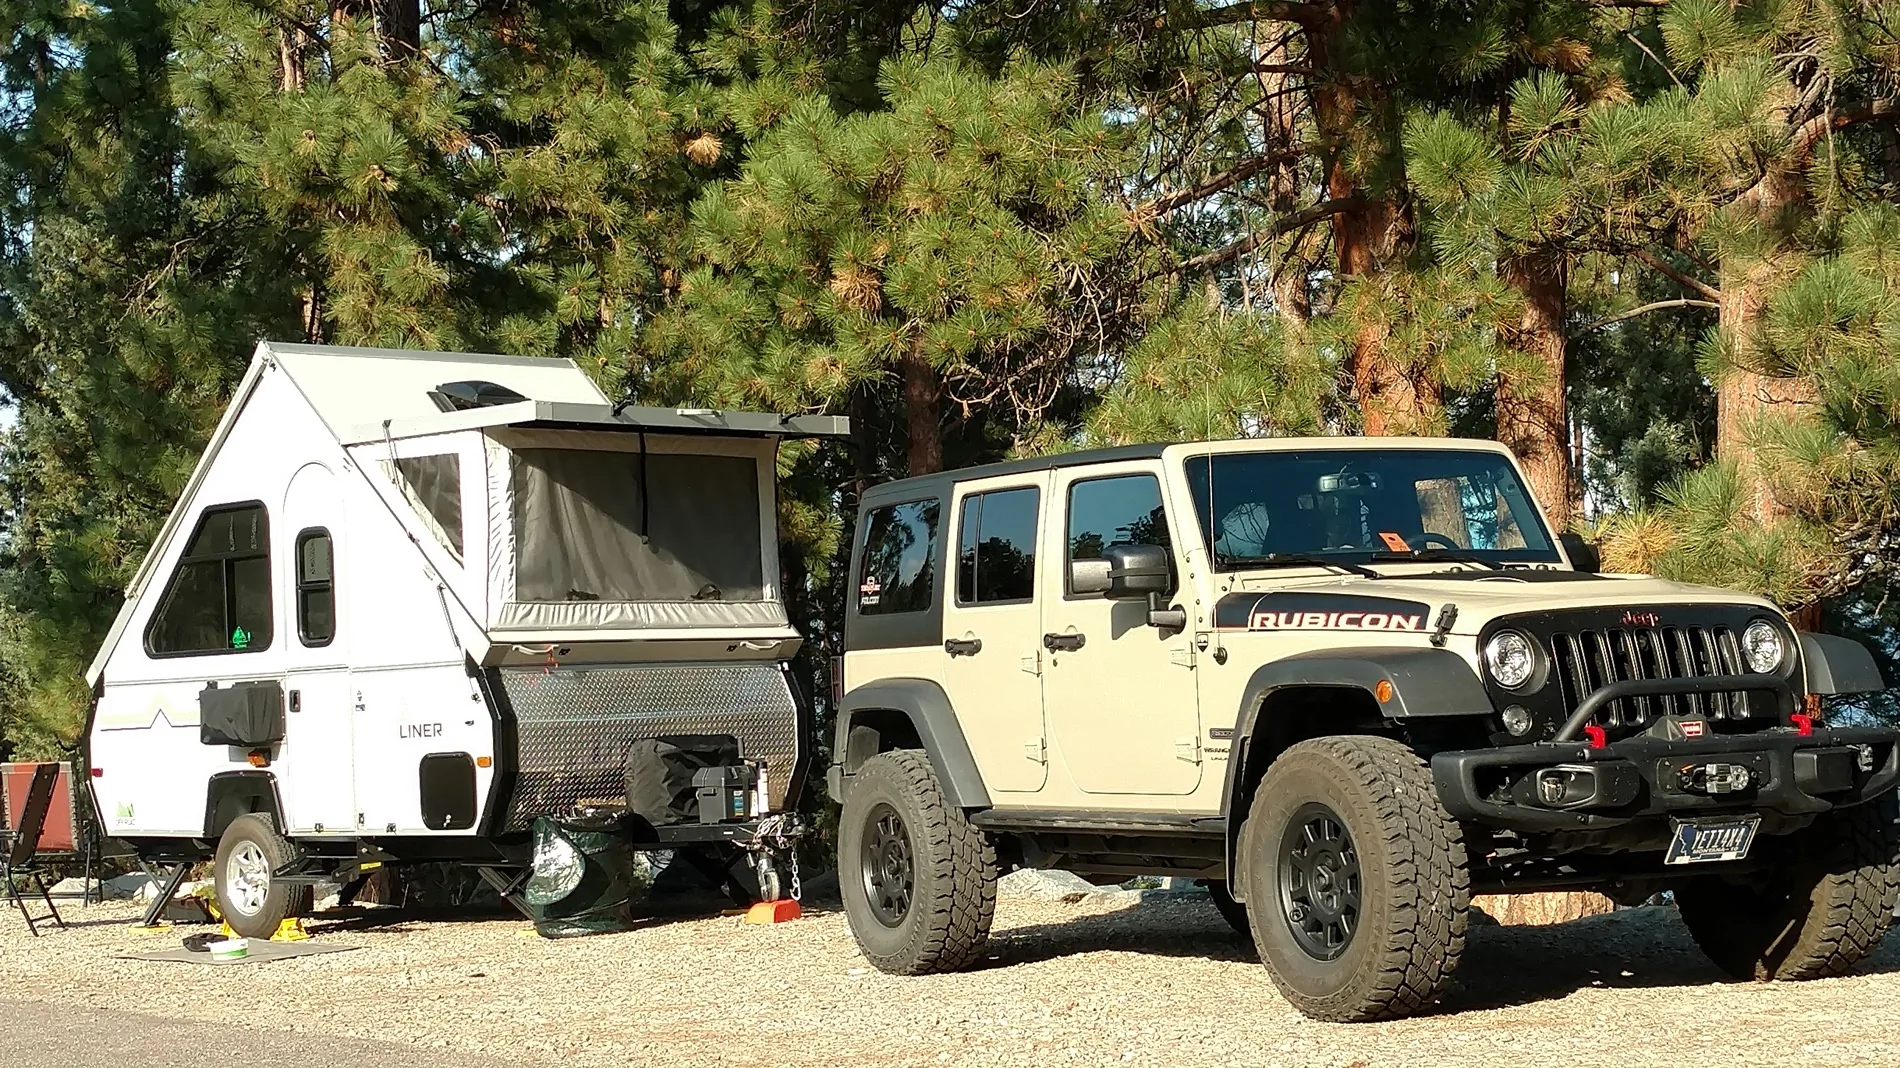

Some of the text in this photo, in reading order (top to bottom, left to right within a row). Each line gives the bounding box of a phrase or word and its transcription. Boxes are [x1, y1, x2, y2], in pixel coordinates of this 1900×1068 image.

[1252, 612, 1422, 631] RUBICON
[400, 723, 442, 739] LINER
[1691, 827, 1746, 850] YETI4X4
